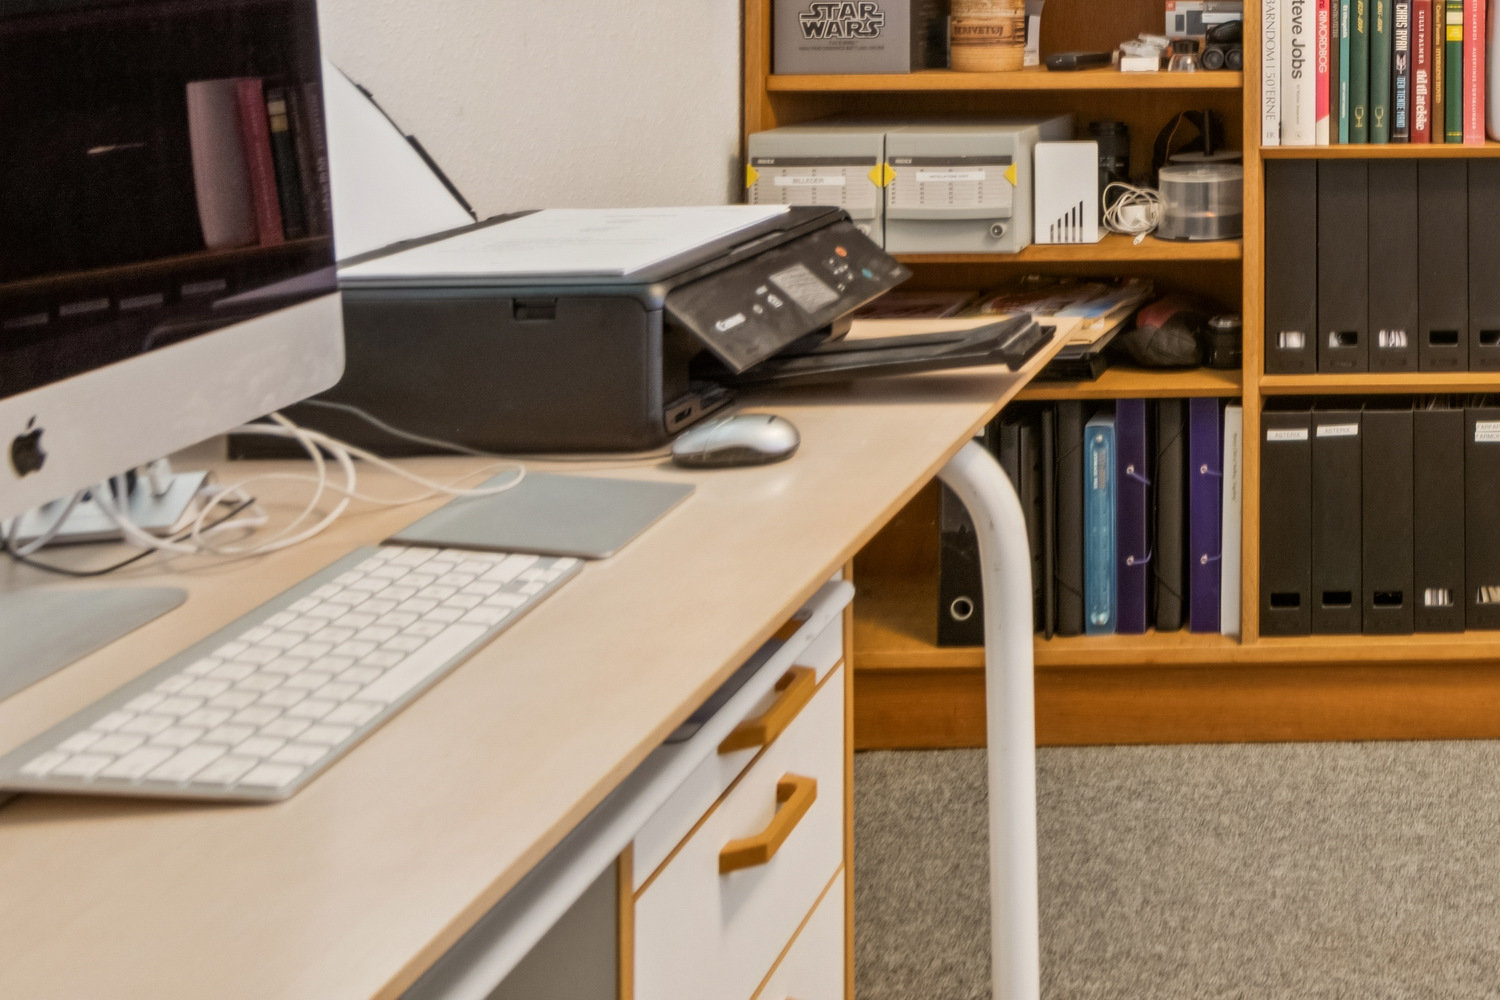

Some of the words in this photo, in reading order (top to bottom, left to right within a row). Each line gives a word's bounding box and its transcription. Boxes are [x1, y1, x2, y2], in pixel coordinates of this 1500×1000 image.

[799, 2, 885, 21] STAR
[1396, 3, 1409, 28] CHRIS
[1418, 10, 1426, 32] LILLI
[799, 20, 885, 40] WARS
[1318, 10, 1329, 74] RIMORDBOG
[1396, 29, 1409, 52] RYAN
[1291, 38, 1307, 80] Jobs
[1417, 33, 1426, 65] PALMER
[1266, 73, 1277, 122] 50'ERNE
[1416, 105, 1428, 131] elske
